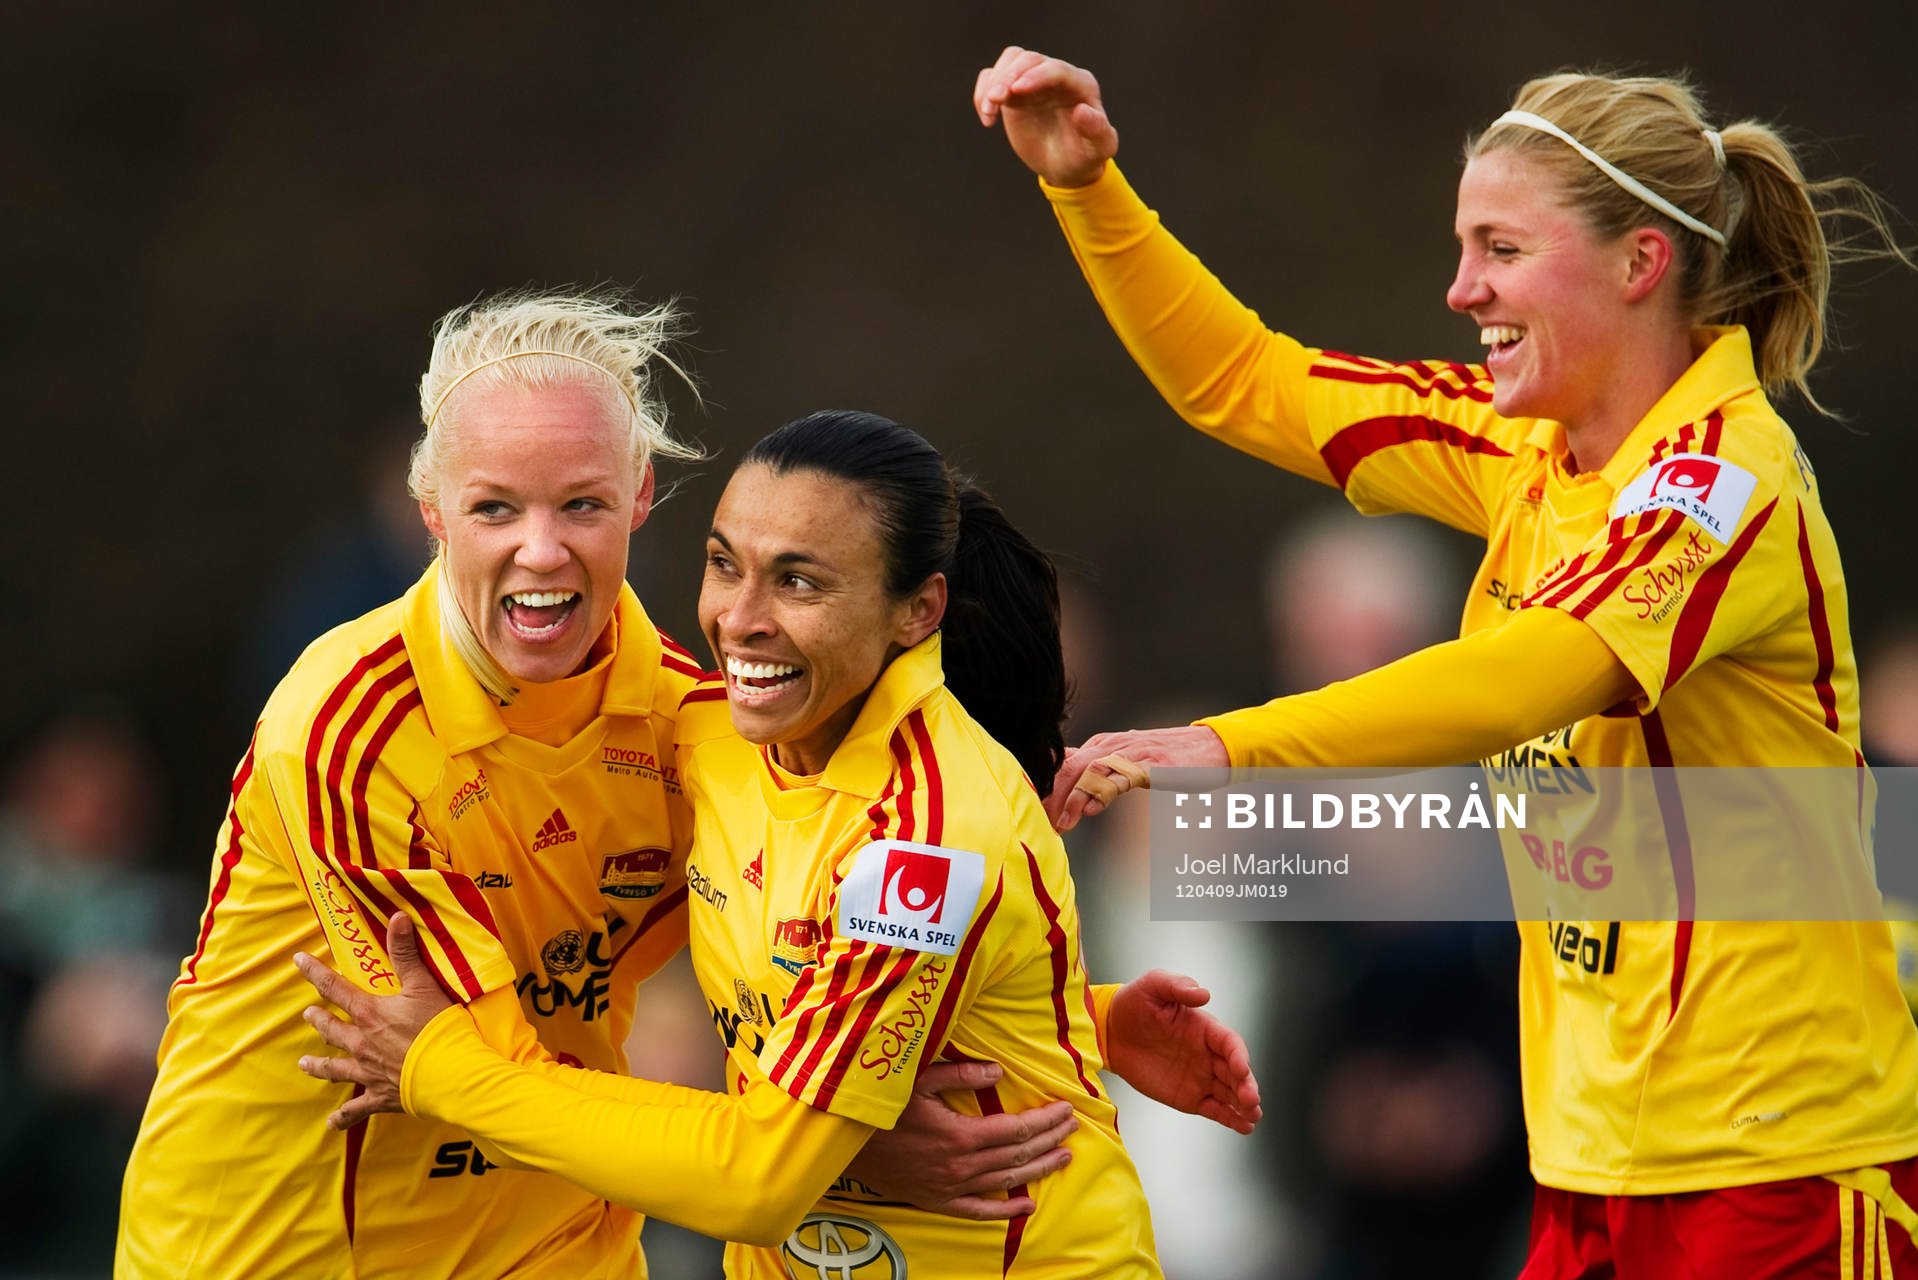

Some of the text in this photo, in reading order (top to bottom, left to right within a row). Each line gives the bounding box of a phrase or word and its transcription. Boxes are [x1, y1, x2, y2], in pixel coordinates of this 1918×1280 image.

[1692, 504, 1721, 533] SPEL
[1623, 528, 1712, 620] Schysst
[1651, 590, 1683, 624] framtid
[603, 747, 655, 768] TOYOTA
[607, 765, 631, 775] Metro
[635, 769, 659, 781] Auto
[532, 830, 577, 853] adidas
[849, 917, 956, 947] SVENSKA SPEL
[860, 956, 946, 1081] Schysst
[892, 1029, 924, 1075] framtid
